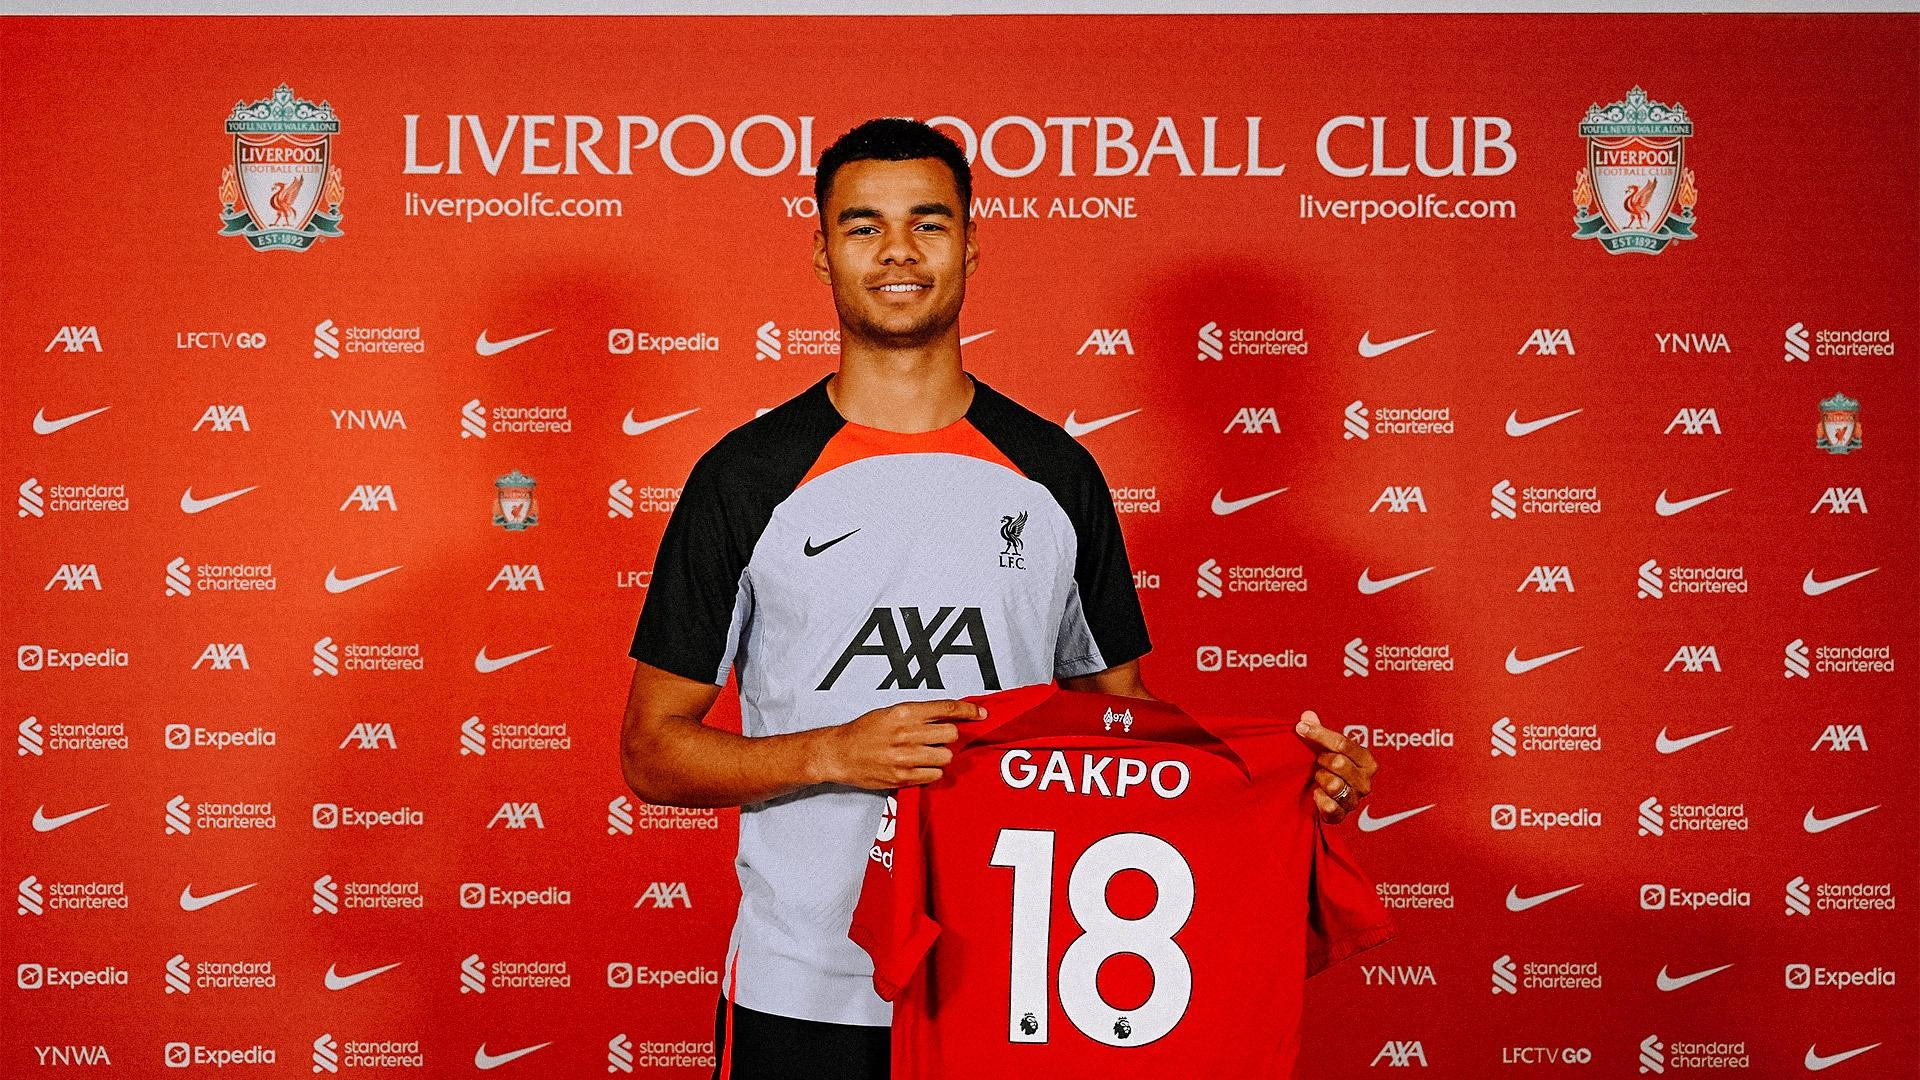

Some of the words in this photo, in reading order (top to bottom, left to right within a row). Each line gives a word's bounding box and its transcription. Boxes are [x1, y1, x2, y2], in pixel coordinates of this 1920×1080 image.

[255, 122, 283, 132] NEVER
[284, 122, 308, 132] WALK
[309, 122, 337, 132] ALONE
[1611, 125, 1637, 135] NEVER
[1637, 125, 1663, 135] WALK
[1663, 125, 1690, 135] ALONE
[403, 114, 816, 177] LIVERPOOL
[884, 115, 1285, 178] OOTBALL
[1316, 115, 1517, 178] CLUB
[241, 147, 323, 163] LIVERPOOL
[1595, 150, 1677, 166] LIVERPOOL
[244, 165, 292, 174] FOOTBALL
[295, 165, 320, 174] CLUB
[1598, 167, 1646, 177] FOOTBALL
[1649, 167, 1673, 177] CLUB
[405, 191, 622, 223] liverpoolfc.com
[969, 197, 1039, 219] WALK
[1047, 196, 1137, 219] ALONE
[1300, 193, 1516, 225] liverpoolfc.com
[45, 326, 103, 353] AXA
[345, 326, 421, 342] standard
[787, 327, 841, 342] standa
[1076, 328, 1134, 355] AXA
[1229, 328, 1304, 342] standard
[1517, 328, 1575, 355] AXA
[1815, 329, 1890, 345] standard
[345, 339, 425, 354] chartered
[637, 332, 720, 354] Expedia
[787, 340, 841, 355] charte
[1228, 341, 1309, 356] chartered
[1655, 333, 1731, 353] YNWA
[1815, 342, 1895, 357] chartered
[192, 405, 251, 432] AXA
[330, 409, 407, 430] YNWA
[492, 406, 567, 421] standard
[1223, 407, 1281, 434] AXA
[1375, 407, 1450, 423] standard
[1664, 408, 1722, 435] AXA
[491, 418, 572, 433] chartered
[1375, 420, 1454, 434] chartered
[50, 484, 125, 500] standard
[340, 484, 397, 512] AXA
[1369, 486, 1427, 513] AXA
[1522, 486, 1597, 502] standard
[49, 497, 130, 512] chartered
[1522, 499, 1602, 514] chartered
[1810, 487, 1868, 514] AXA
[44, 564, 102, 591] AXA
[197, 563, 272, 579] standard
[487, 564, 545, 591] AXA
[1228, 565, 1303, 581] standard
[1517, 565, 1575, 593] AXA
[1669, 566, 1744, 582] standard
[197, 577, 277, 591] chartered
[1228, 578, 1308, 593] chartered
[1668, 579, 1748, 594] chartered
[192, 643, 250, 670] AXA
[344, 643, 420, 659] standard
[815, 606, 1001, 691] AXA
[1375, 644, 1450, 659] standard
[1815, 645, 1890, 661] standard
[47, 648, 129, 671] Expedia
[344, 656, 424, 671] chartered
[1226, 649, 1308, 672] Expedia
[1374, 657, 1455, 672] chartered
[1664, 645, 1722, 672] AXA
[1815, 658, 1895, 673] chartered
[1113, 714, 1124, 722] 97
[49, 722, 125, 738] standard
[339, 723, 397, 749] AXA
[491, 723, 567, 739] standard
[1522, 723, 1597, 740] standard
[1810, 724, 1869, 751] AXA
[49, 735, 129, 750] chartered
[194, 727, 276, 750] Expedia
[491, 736, 571, 750] chartered
[1372, 728, 1454, 751] Expedia
[1522, 737, 1602, 751] chartered
[999, 748, 1191, 800] GAKPO
[196, 801, 272, 818] standard
[486, 802, 545, 829] AXA
[1669, 803, 1744, 819] standard
[196, 815, 276, 829] chartered
[342, 807, 424, 829] Expedia
[639, 815, 719, 829] chartered
[1520, 808, 1602, 831] Expedia
[1669, 816, 1749, 831] chartered
[49, 881, 124, 896] standard
[344, 881, 419, 897] standard
[634, 882, 692, 909] AXA
[1375, 881, 1450, 896] standard
[1816, 883, 1891, 899] standard
[49, 895, 129, 910] chartered
[344, 894, 424, 909] chartered
[489, 886, 571, 909] Expedia
[1379, 895, 1454, 909] hartered
[1669, 887, 1751, 910] Expedia
[1816, 896, 1896, 910] chartered
[988, 827, 1196, 1049] 18
[196, 960, 272, 975] standard
[491, 960, 567, 977] standard
[1360, 965, 1437, 986] YNWA
[1523, 961, 1598, 977] standard
[47, 966, 129, 989] Expedia
[196, 974, 276, 988] chartered
[491, 974, 571, 988] chartered
[637, 966, 719, 989] Expedia
[1523, 974, 1602, 989] chartered
[1814, 967, 1896, 990] Expedia
[344, 1040, 419, 1056] standard
[639, 1040, 714, 1054] standard
[1370, 1040, 1428, 1067] AXA
[1670, 1041, 1745, 1055] standard
[34, 1045, 111, 1066] YNWA
[194, 1045, 276, 1068] Expedia
[344, 1053, 424, 1068] chartered
[1670, 1054, 1750, 1069] chartered
